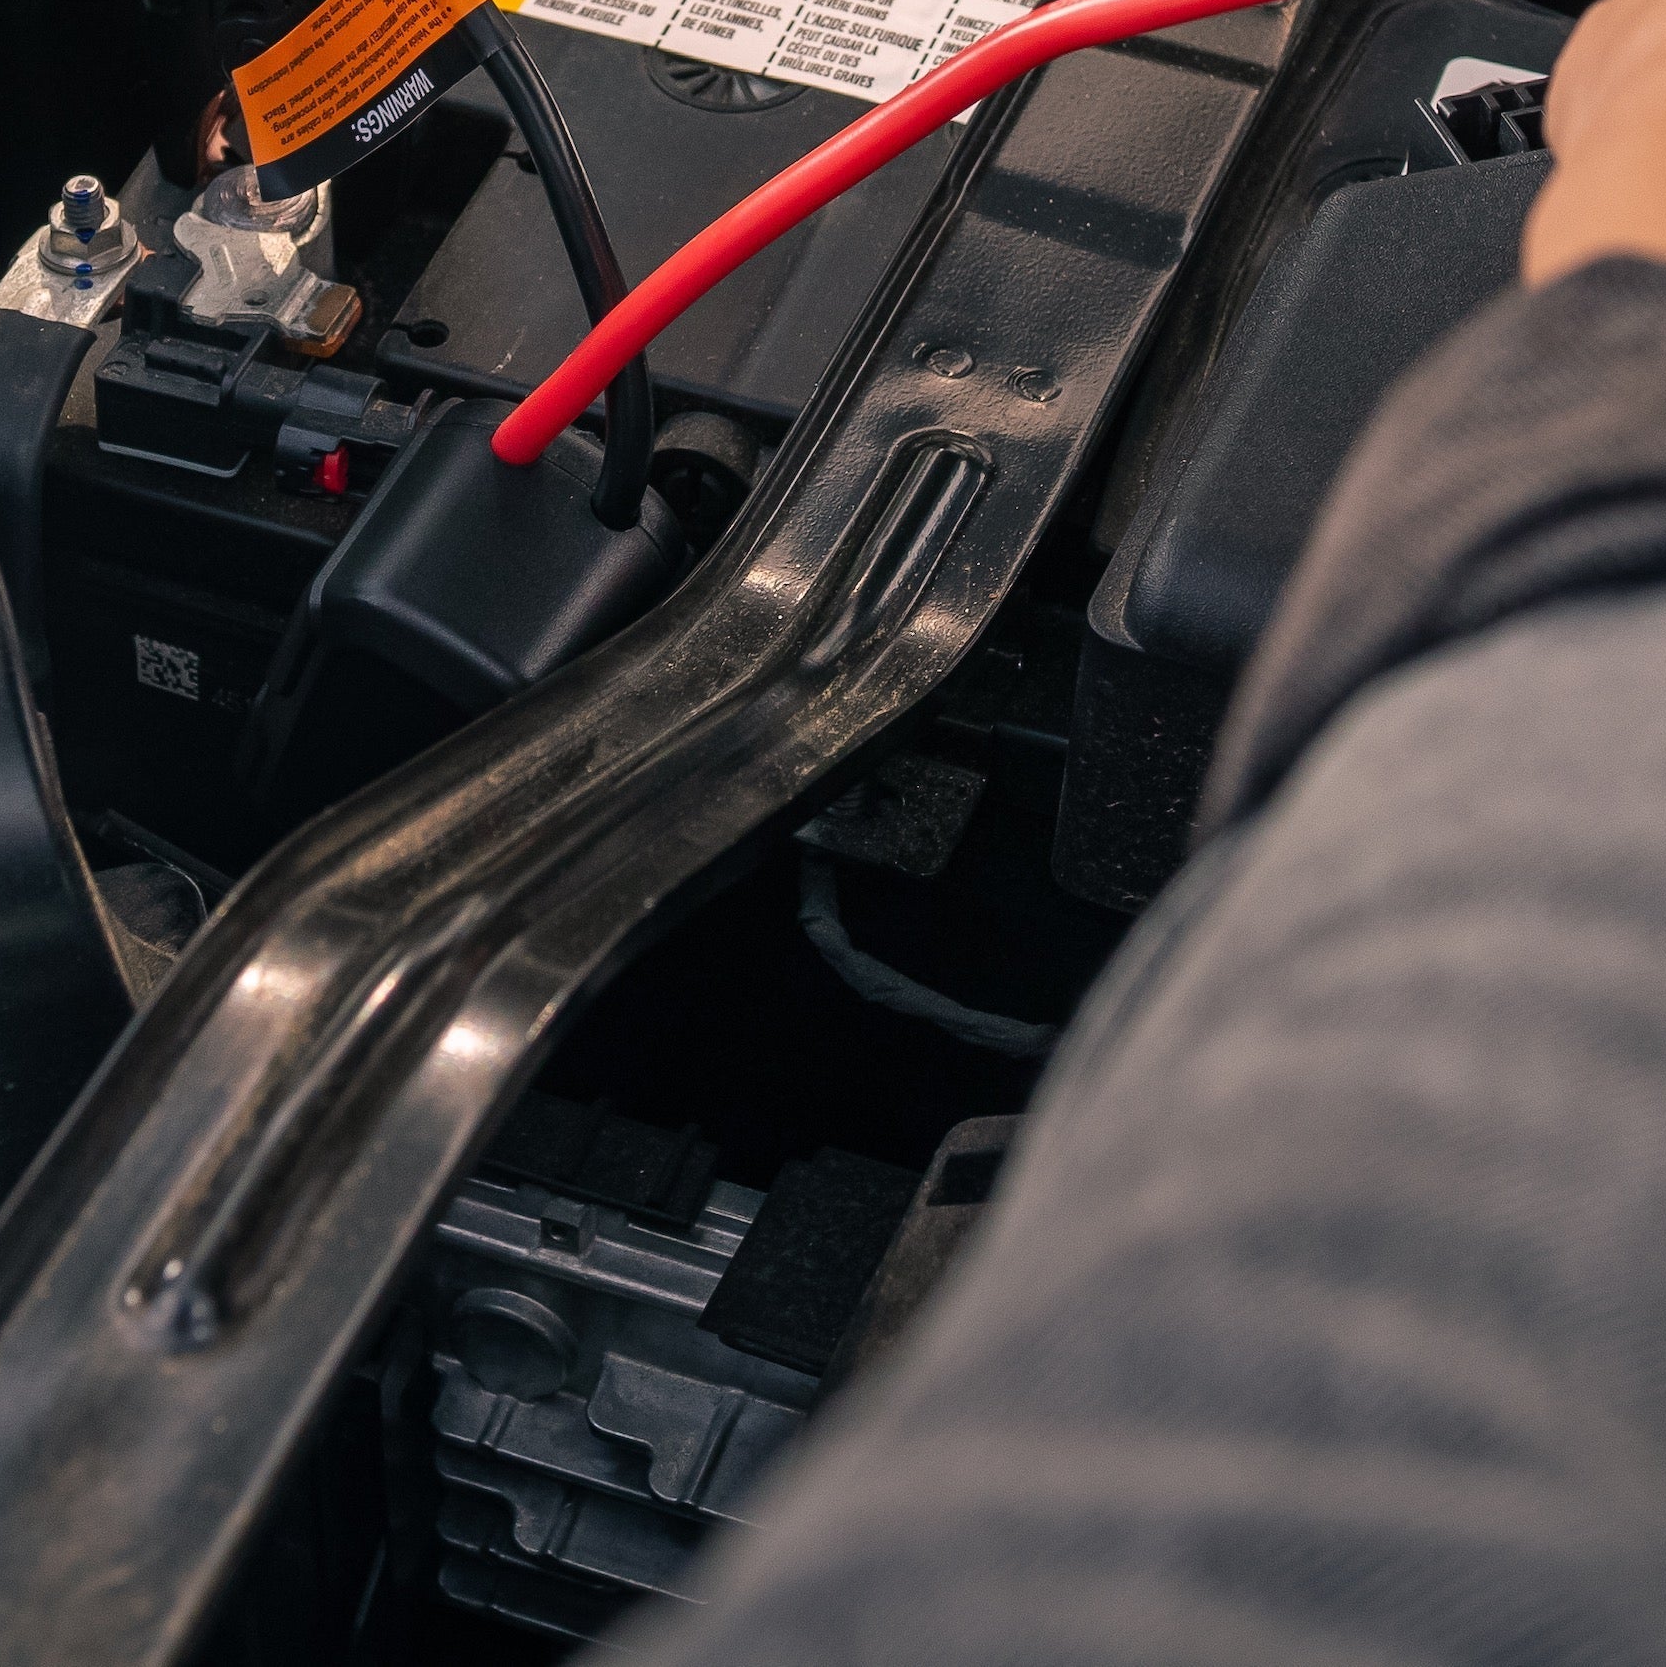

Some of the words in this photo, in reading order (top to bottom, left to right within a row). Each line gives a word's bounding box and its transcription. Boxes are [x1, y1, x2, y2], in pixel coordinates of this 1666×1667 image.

[333, 2, 365, 32] instructions
[419, 4, 430, 17] all
[689, 3, 711, 17] LES
[852, 4, 888, 21] BURNS
[401, 12, 421, 32] vehicle
[427, 16, 443, 29] the
[681, 17, 698, 29] DE
[697, 21, 736, 39] FUMER
[314, 37, 325, 49] the
[323, 28, 334, 41] see
[408, 28, 430, 47] Vehicle
[794, 27, 823, 42] PEUT
[864, 44, 878, 56] LA
[848, 23, 924, 52] SULFURIQUE
[345, 50, 357, 62] the
[356, 39, 369, 55] after
[289, 44, 315, 71] supplied
[838, 54, 861, 68] DES
[247, 65, 290, 96] instruction
[359, 74, 377, 93] smart
[833, 69, 875, 88] GRAVES
[317, 85, 339, 105] before
[335, 87, 359, 111] alligator
[262, 103, 287, 123] Black
[322, 107, 335, 120] clip
[351, 67, 435, 144] WARNINGS:
[296, 116, 321, 137] cables
[280, 132, 295, 145] are
